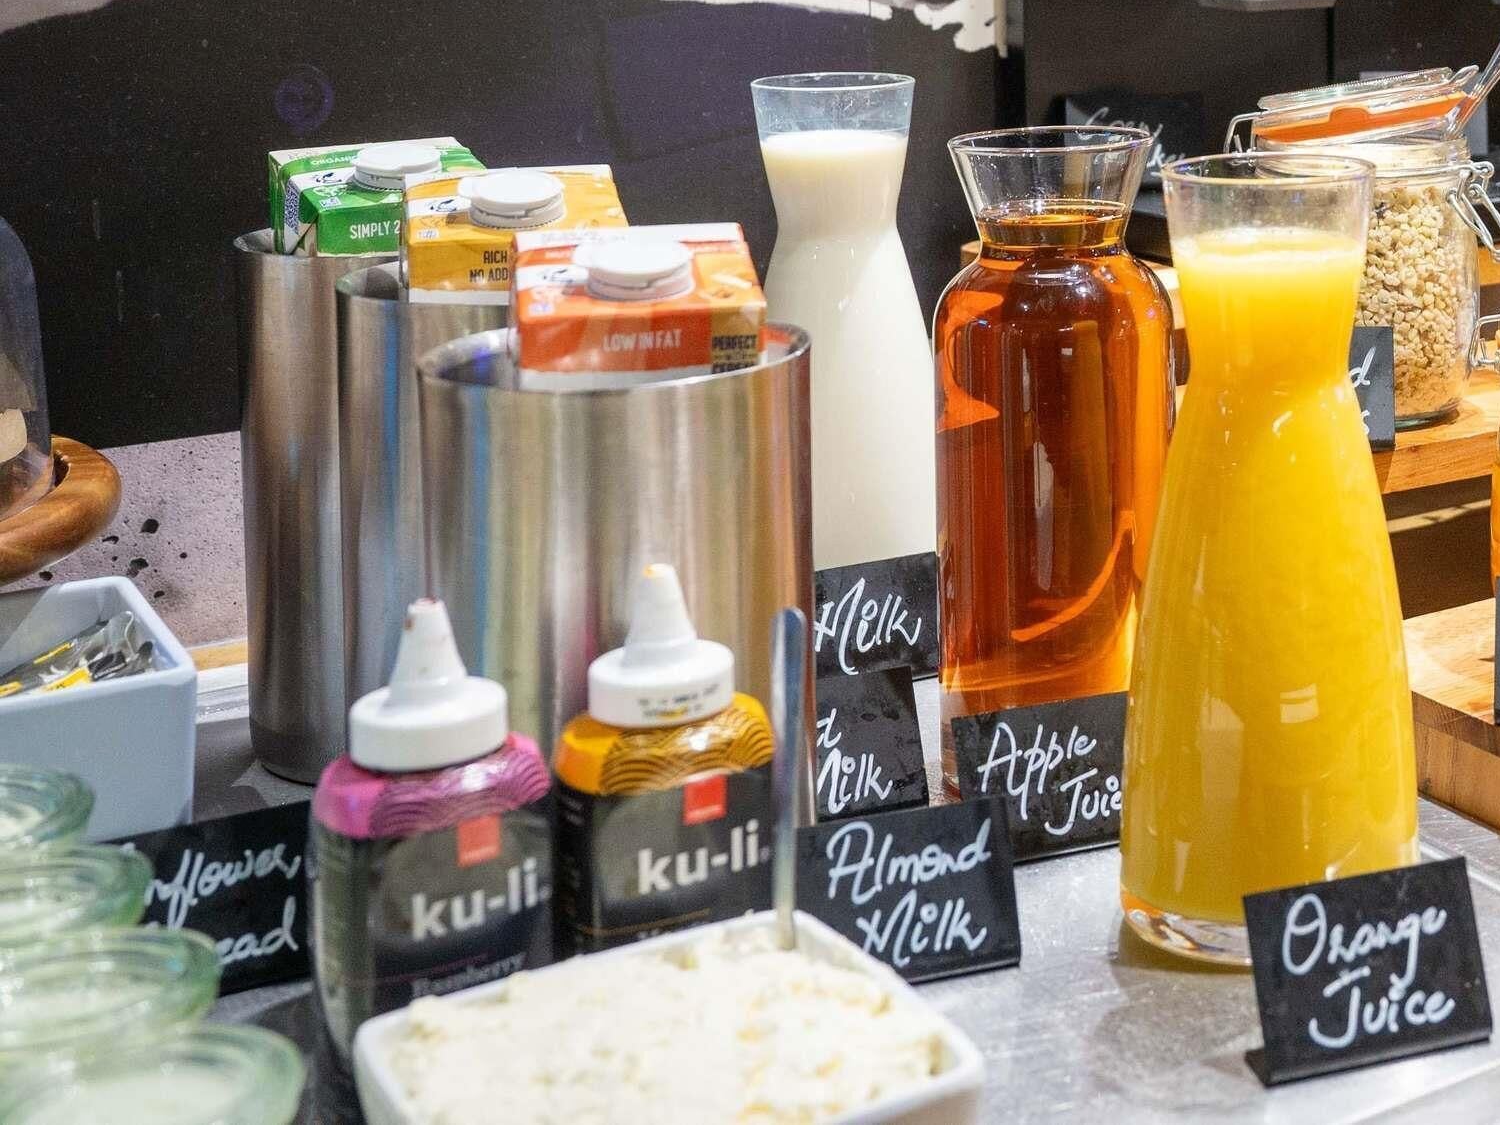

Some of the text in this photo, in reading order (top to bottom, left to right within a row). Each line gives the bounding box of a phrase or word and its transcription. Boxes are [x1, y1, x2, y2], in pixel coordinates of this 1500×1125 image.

[350, 221, 391, 240] SIMPLY
[483, 250, 508, 265] RICH
[603, 328, 683, 354] LOW IN FAT
[814, 577, 922, 675] Milk
[976, 721, 1098, 822] Apple
[826, 817, 993, 905] Almond
[855, 889, 989, 967] Milk
[1282, 892, 1448, 987] Orange
[1308, 965, 1457, 1049] Juice
